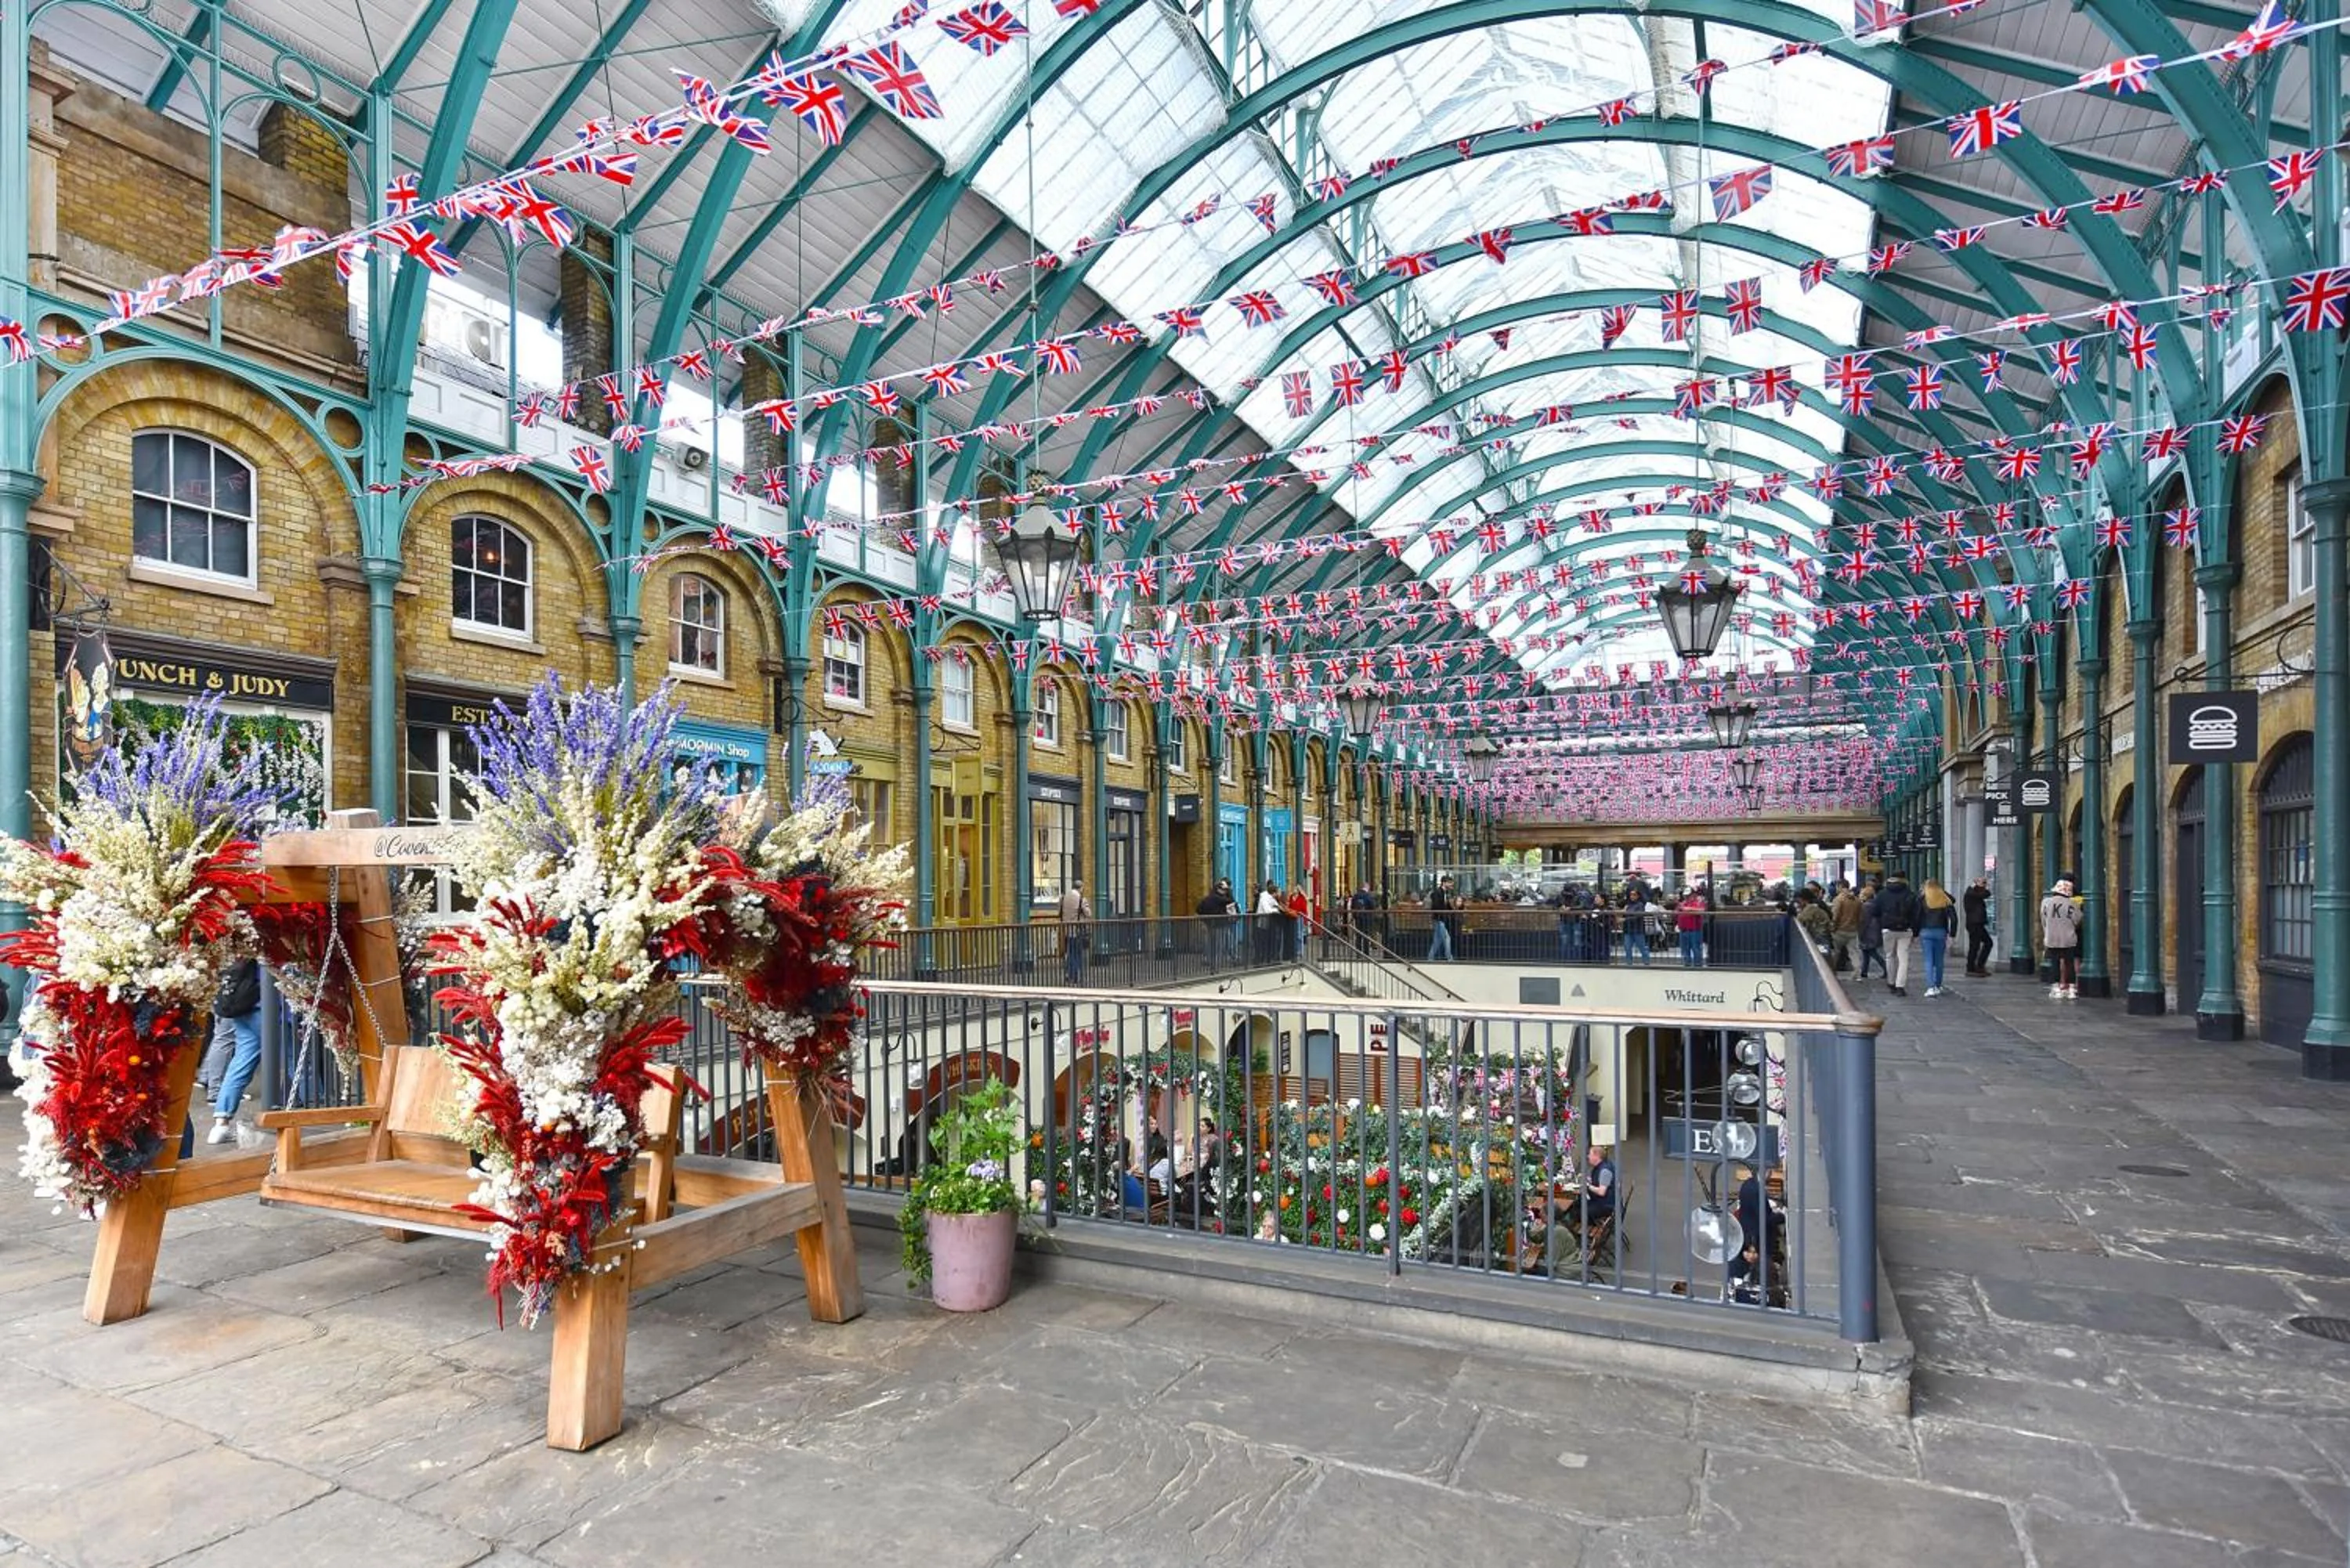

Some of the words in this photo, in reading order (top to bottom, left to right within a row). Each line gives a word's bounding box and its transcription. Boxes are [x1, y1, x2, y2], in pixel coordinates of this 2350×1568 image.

[115, 659, 197, 686] UNCH
[206, 670, 224, 689] &
[229, 674, 291, 697] JUDY
[727, 742, 750, 758] Shop
[1665, 989, 1726, 1003] Whittard
